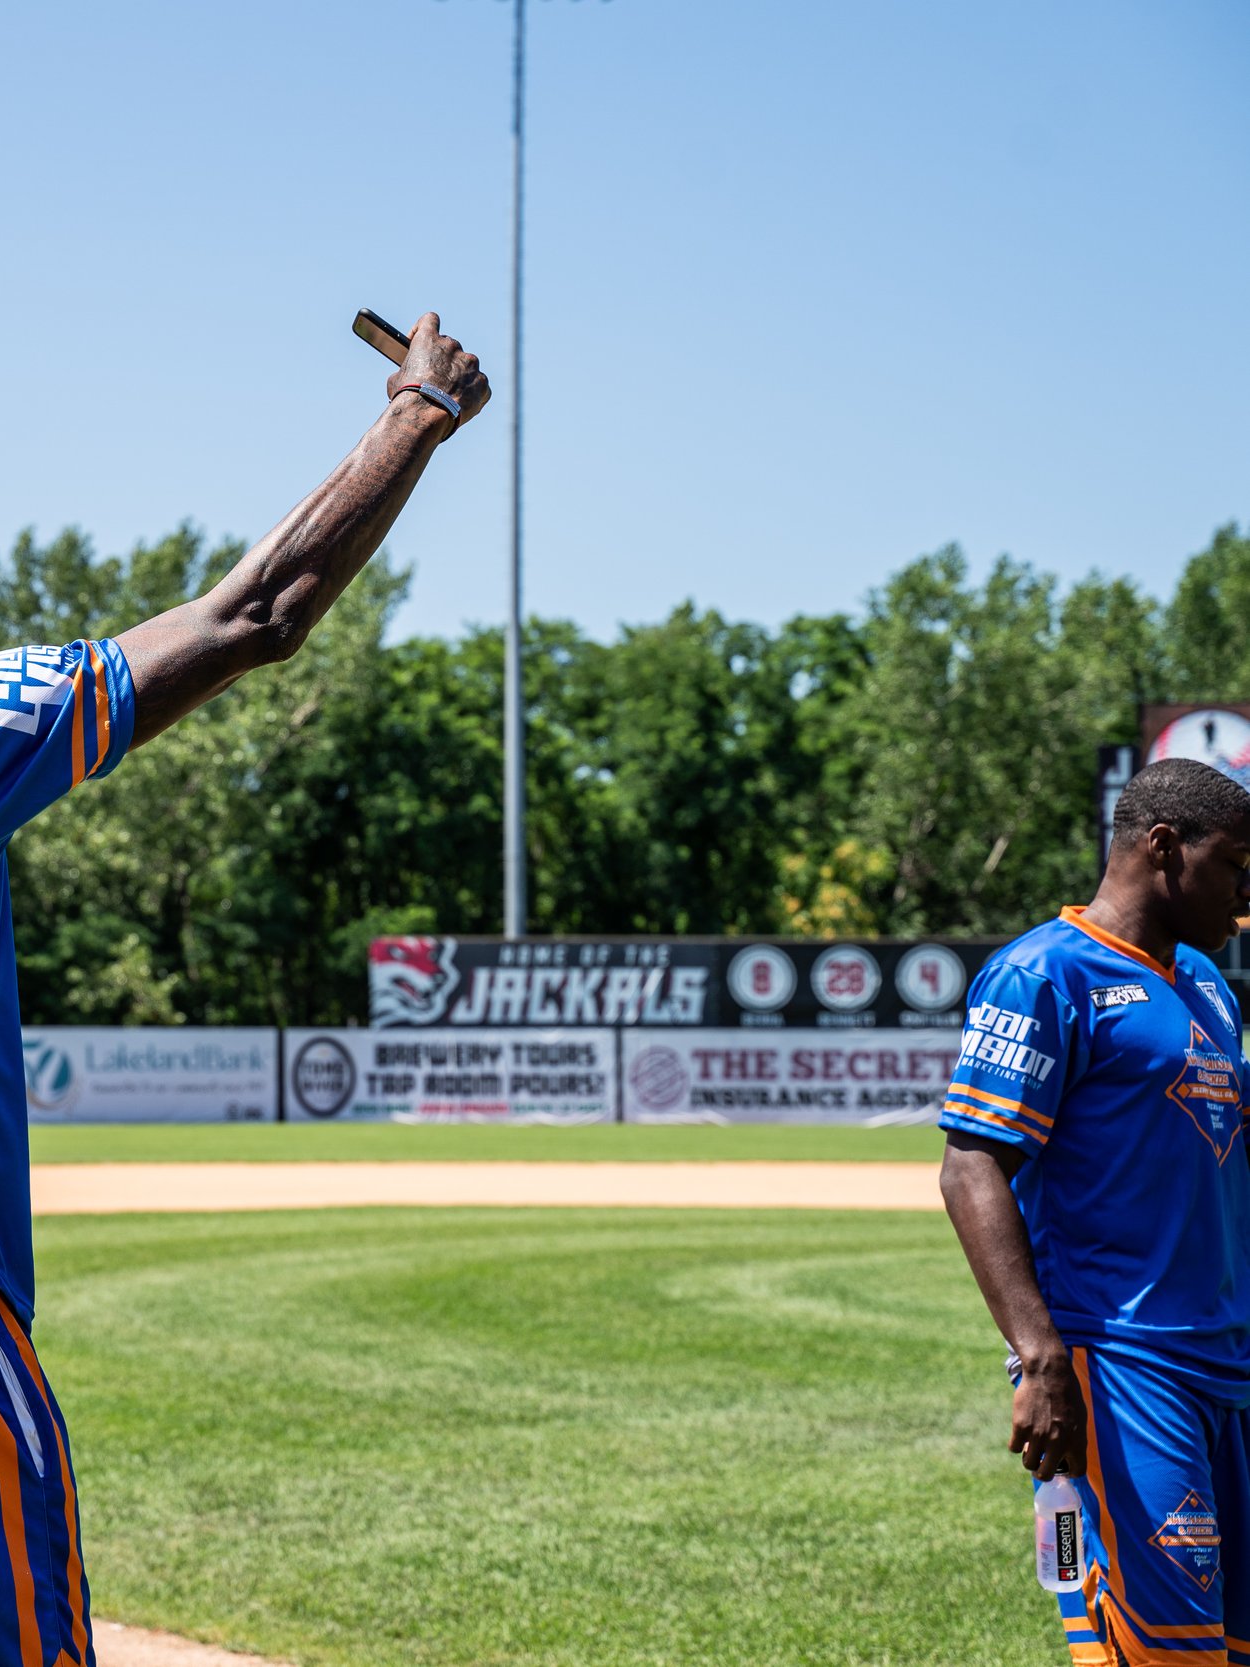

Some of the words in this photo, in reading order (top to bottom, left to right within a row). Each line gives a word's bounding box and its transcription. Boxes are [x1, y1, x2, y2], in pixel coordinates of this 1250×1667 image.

[500, 944, 567, 966] HOME
[579, 945, 612, 966] OF
[624, 944, 671, 967] THE
[918, 961, 941, 996] 4
[450, 965, 710, 1026] JACKALS
[374, 1042, 502, 1067] BREWERY
[510, 1042, 597, 1067] TOURS
[691, 1048, 777, 1082] THE
[788, 1048, 960, 1083] SECRET
[961, 1057, 1018, 1081] MARKETING
[365, 1073, 416, 1097] TAP
[423, 1073, 502, 1097] ROOM
[690, 1086, 847, 1109] INSURANCE
[854, 1086, 952, 1109] AGENC
[1058, 1514, 1073, 1564] essentia
